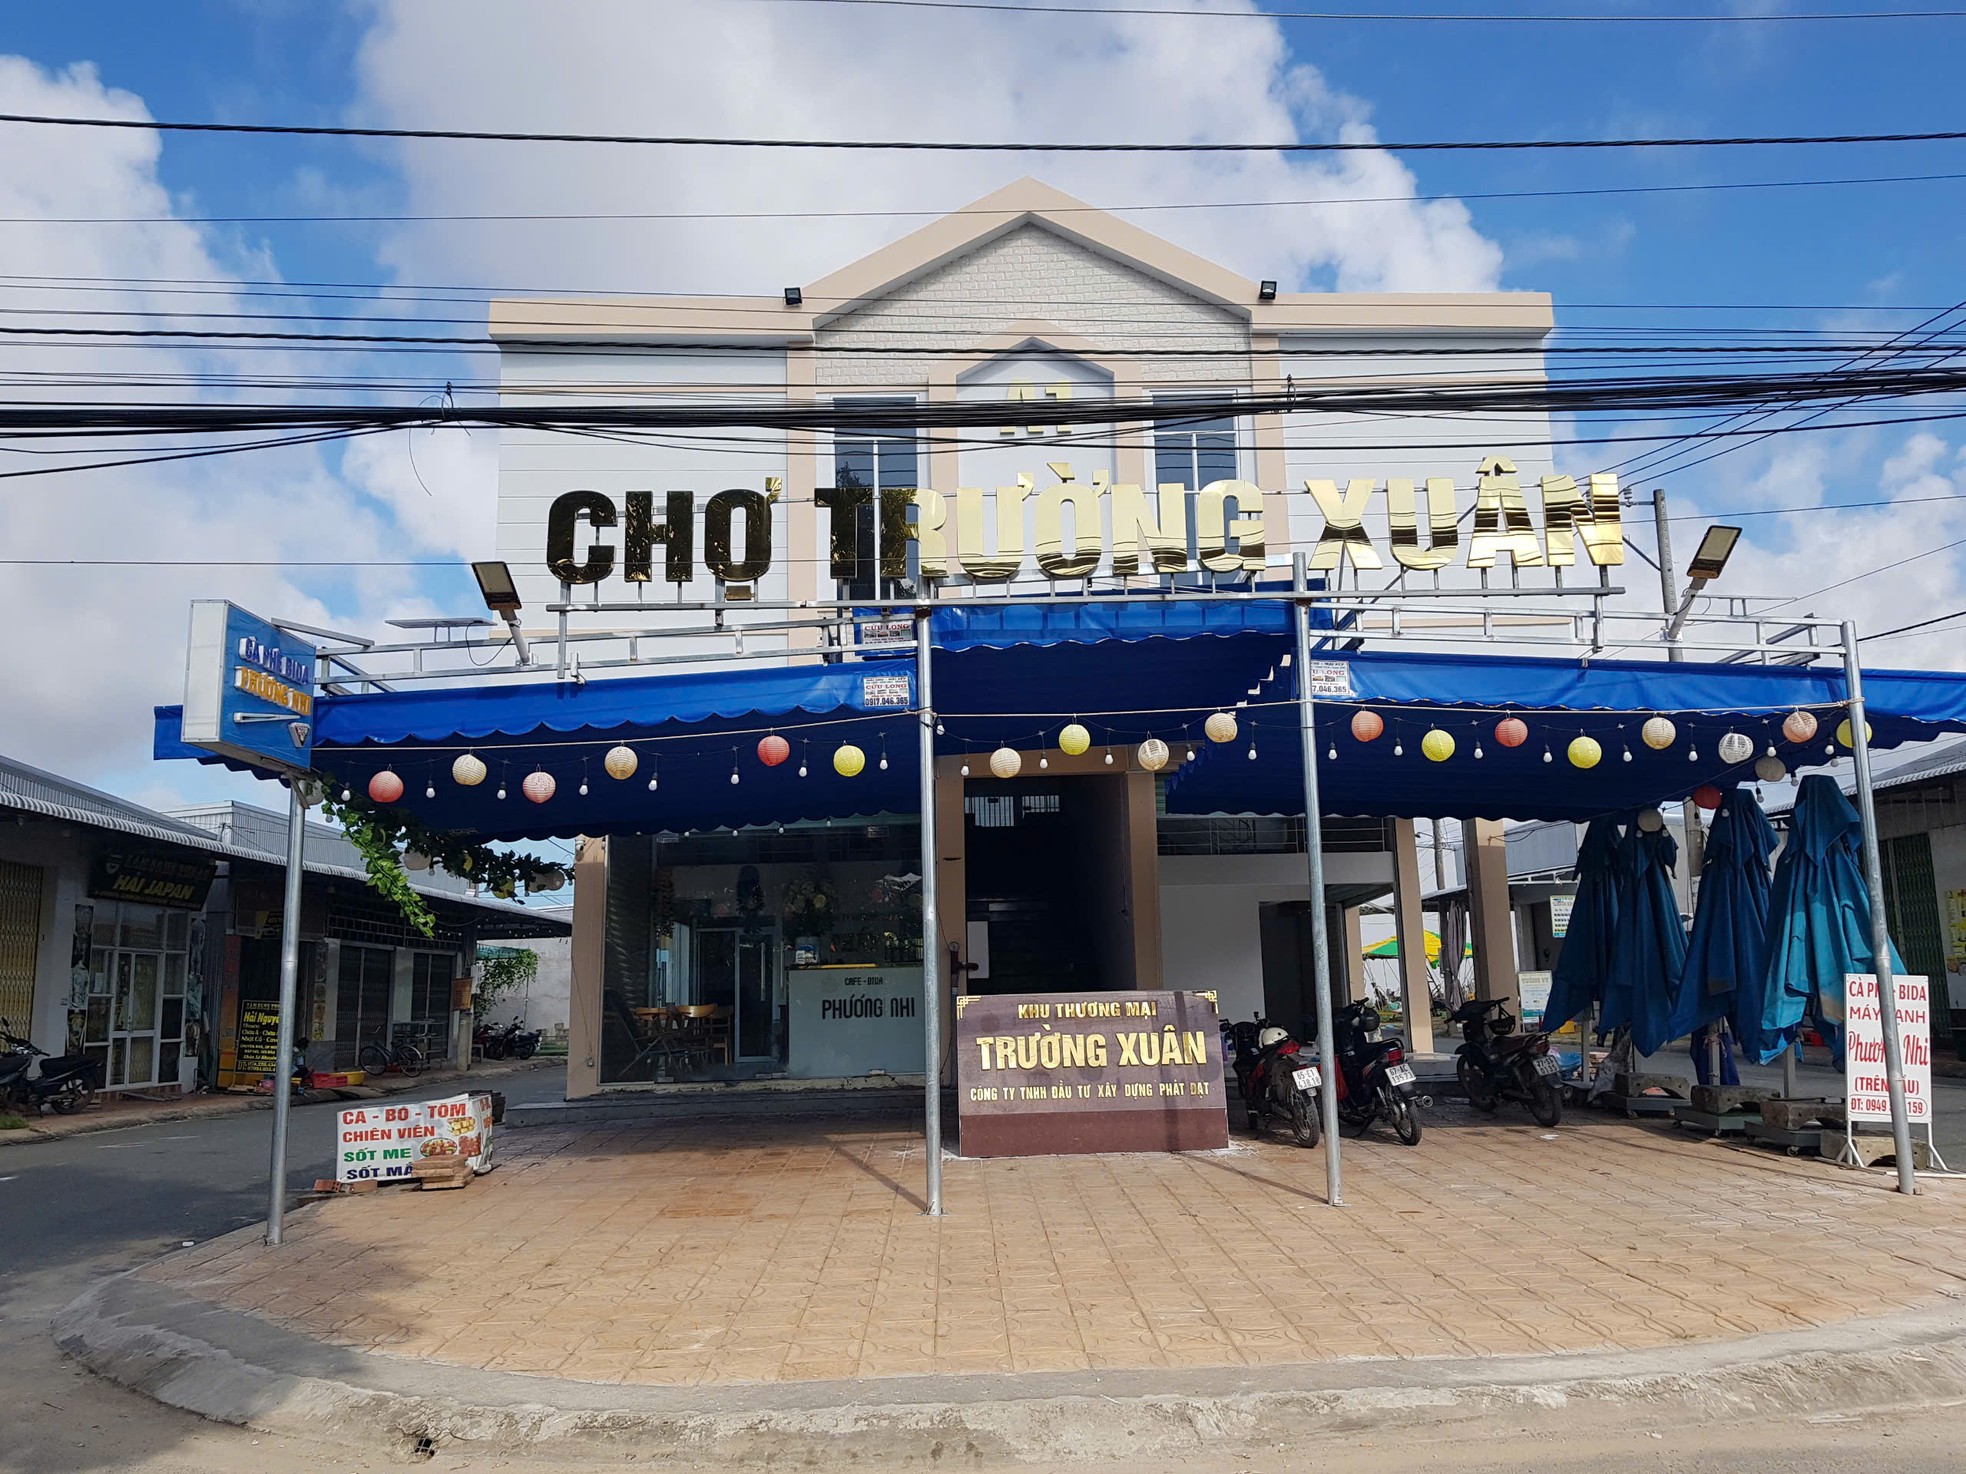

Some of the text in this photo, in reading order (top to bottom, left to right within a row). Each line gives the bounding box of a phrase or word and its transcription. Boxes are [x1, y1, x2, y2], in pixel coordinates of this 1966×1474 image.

[547, 455, 1624, 601] CHỢ TRƯỜNG XUÂN
[144, 879, 195, 900] JAPAN
[844, 976, 862, 986] CAFE
[1849, 977, 1864, 997] CÀ
[1899, 984, 1927, 1001] BIDA
[890, 996, 915, 1018] NHI
[1018, 1001, 1157, 1020] KHU THƯƠNG MẠI
[1849, 1004, 1926, 1026] MÁY ẠNH
[976, 1023, 1208, 1071] TRƯỜNG XUÂN
[1903, 1034, 1929, 1067] Nhi
[970, 1086, 998, 1101] CÔNG
[1002, 1087, 1015, 1100] TY
[1020, 1086, 1047, 1100] TNHH
[1051, 1080, 1072, 1099] ĐẦU
[1077, 1084, 1092, 1099] TƯ
[1097, 1082, 1118, 1098] XÂY
[1125, 1082, 1153, 1100] DỰNG
[1159, 1079, 1185, 1096] PHÁT
[1855, 1075, 1889, 1093] (TRÊN
[1851, 1098, 1923, 1114] ĐT: 0949 159
[342, 1124, 436, 1143] CHIÊN VIÊN
[343, 1147, 411, 1163] SỐT ME
[346, 1164, 380, 1180] SỐT
